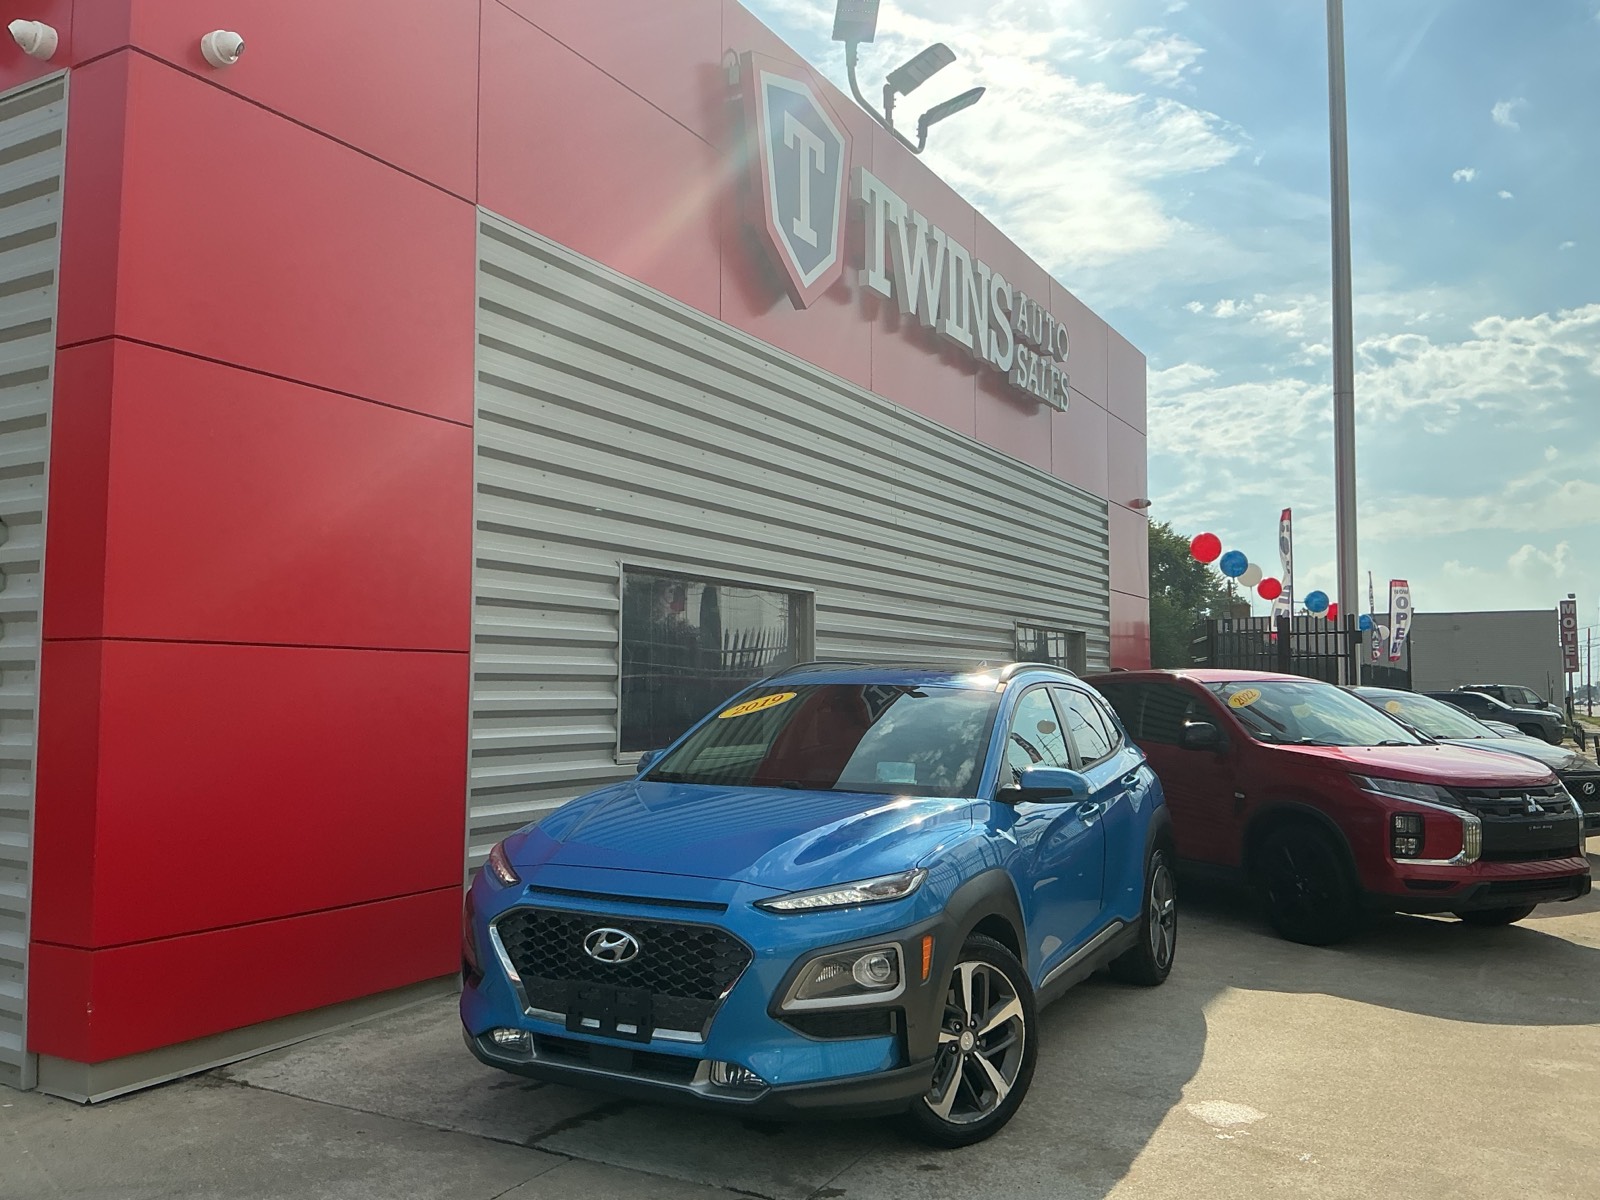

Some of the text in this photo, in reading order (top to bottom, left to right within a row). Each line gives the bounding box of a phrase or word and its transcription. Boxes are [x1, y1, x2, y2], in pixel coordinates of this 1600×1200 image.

[783, 110, 826, 248] T
[861, 166, 1014, 372] TWINS
[1016, 291, 1070, 363] AUTO
[1016, 343, 1070, 412] SALES
[1392, 596, 1409, 654] OPEN
[1561, 604, 1576, 669] MOTEL
[731, 694, 784, 715] 2019
[1233, 689, 1257, 707] 2022
